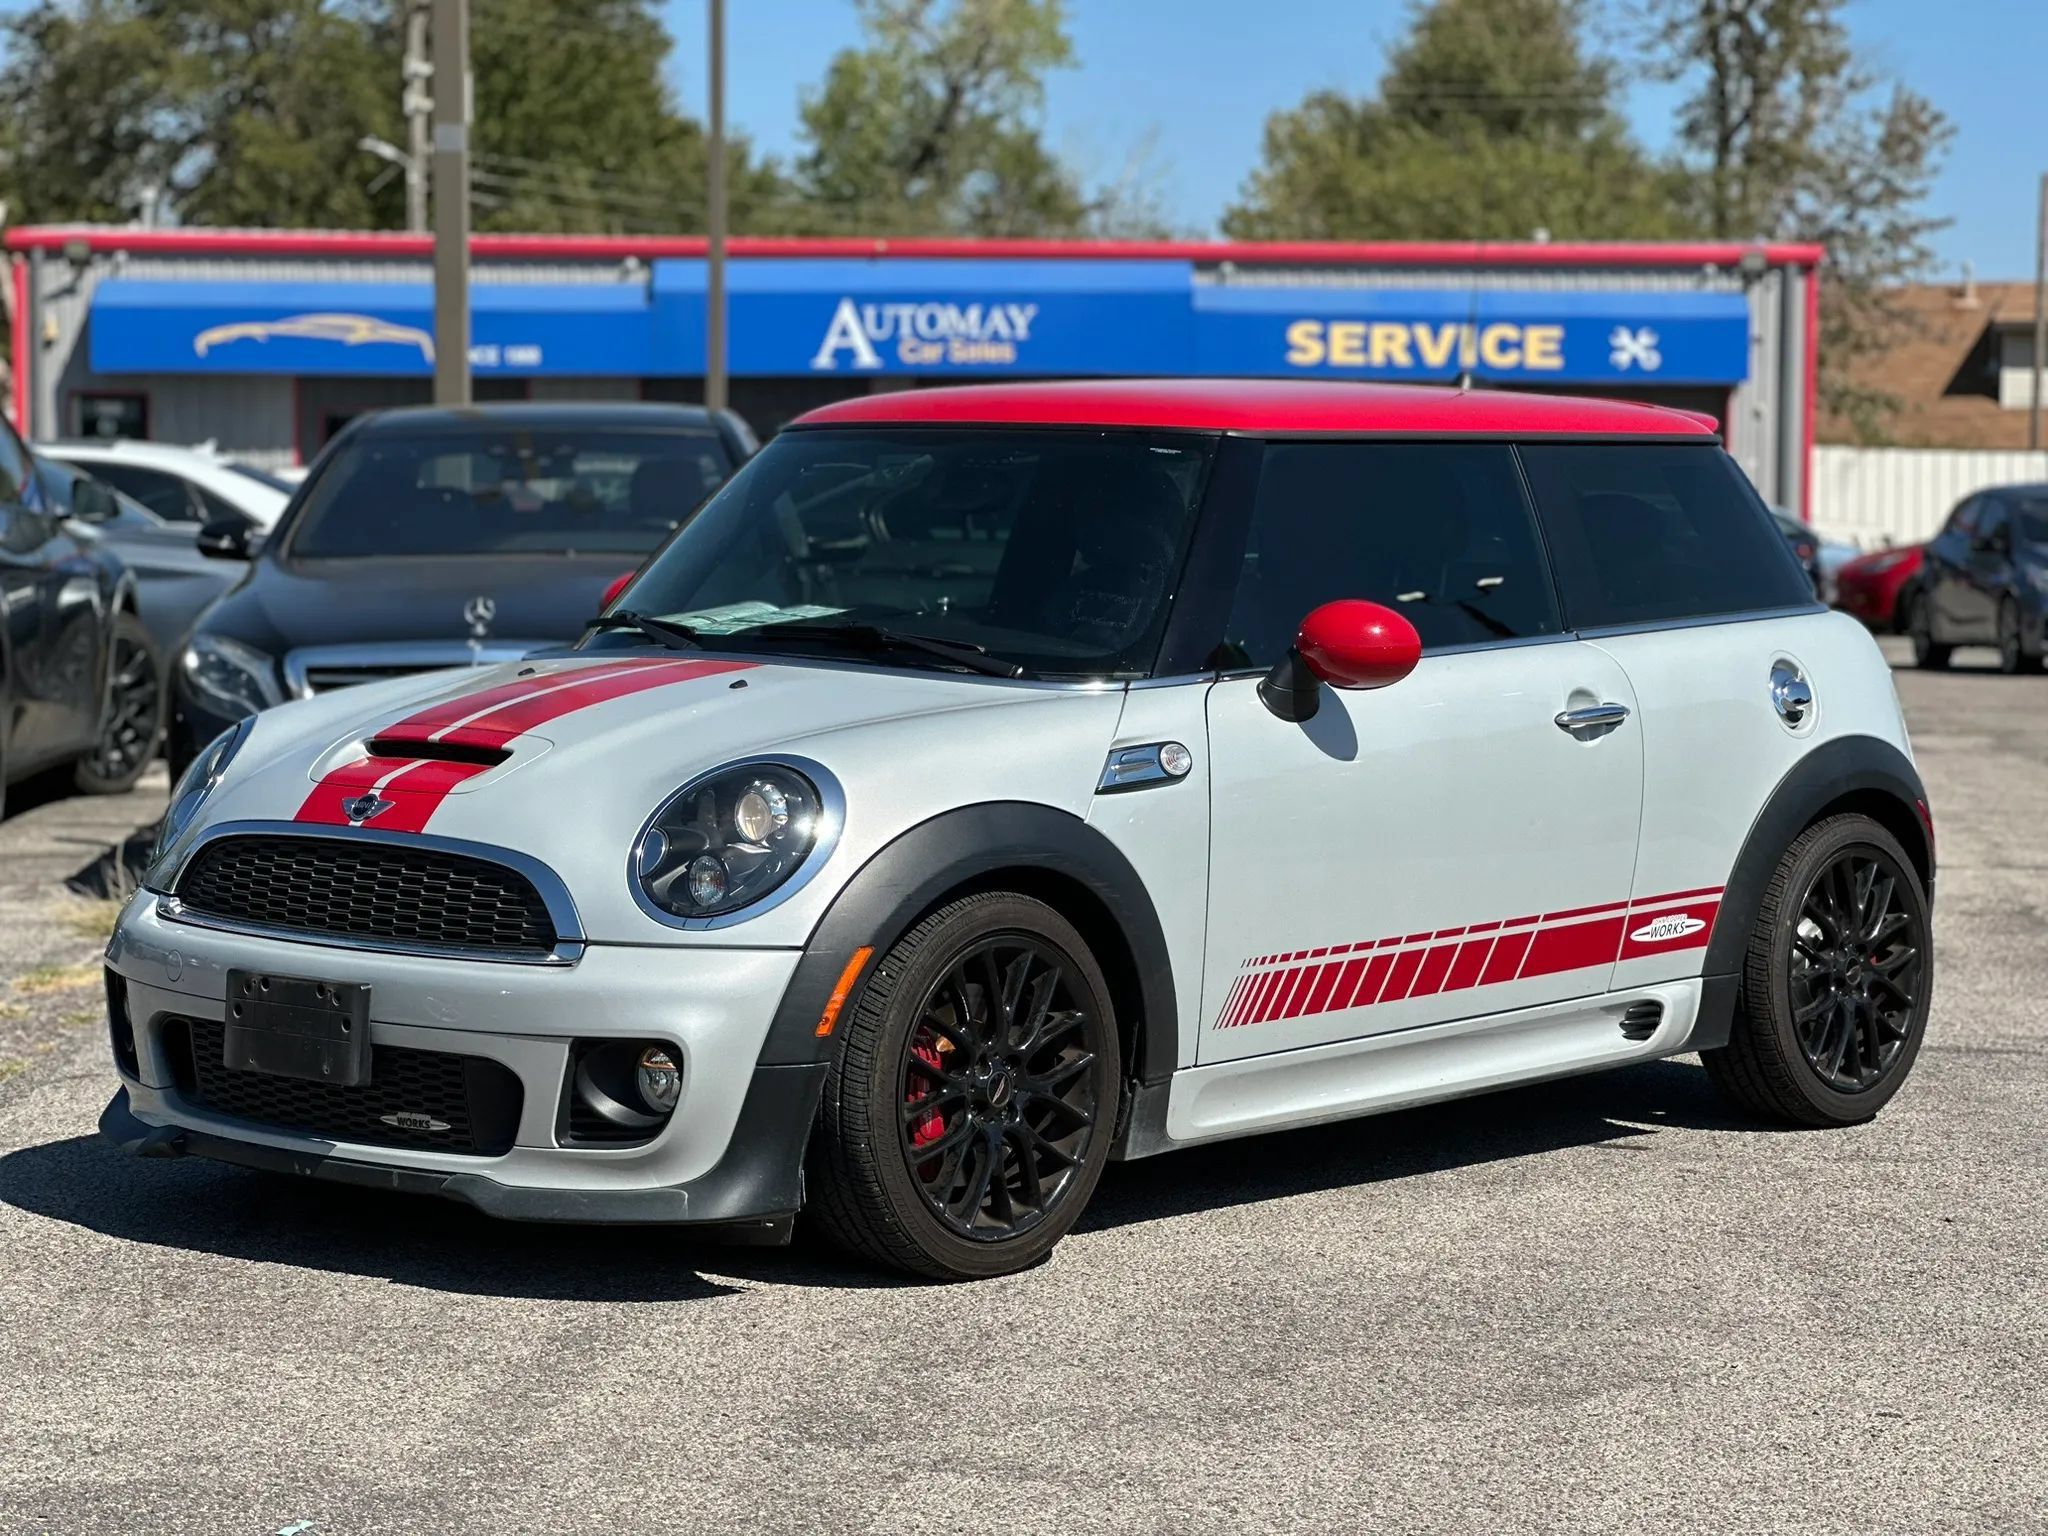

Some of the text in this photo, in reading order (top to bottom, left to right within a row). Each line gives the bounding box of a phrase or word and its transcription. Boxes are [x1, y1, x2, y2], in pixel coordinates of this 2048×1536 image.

[898, 340, 1015, 364] Car Sales
[1287, 320, 1564, 370] SERVICE
[1651, 921, 1685, 938] WORKS
[397, 1116, 430, 1129] WORKS
